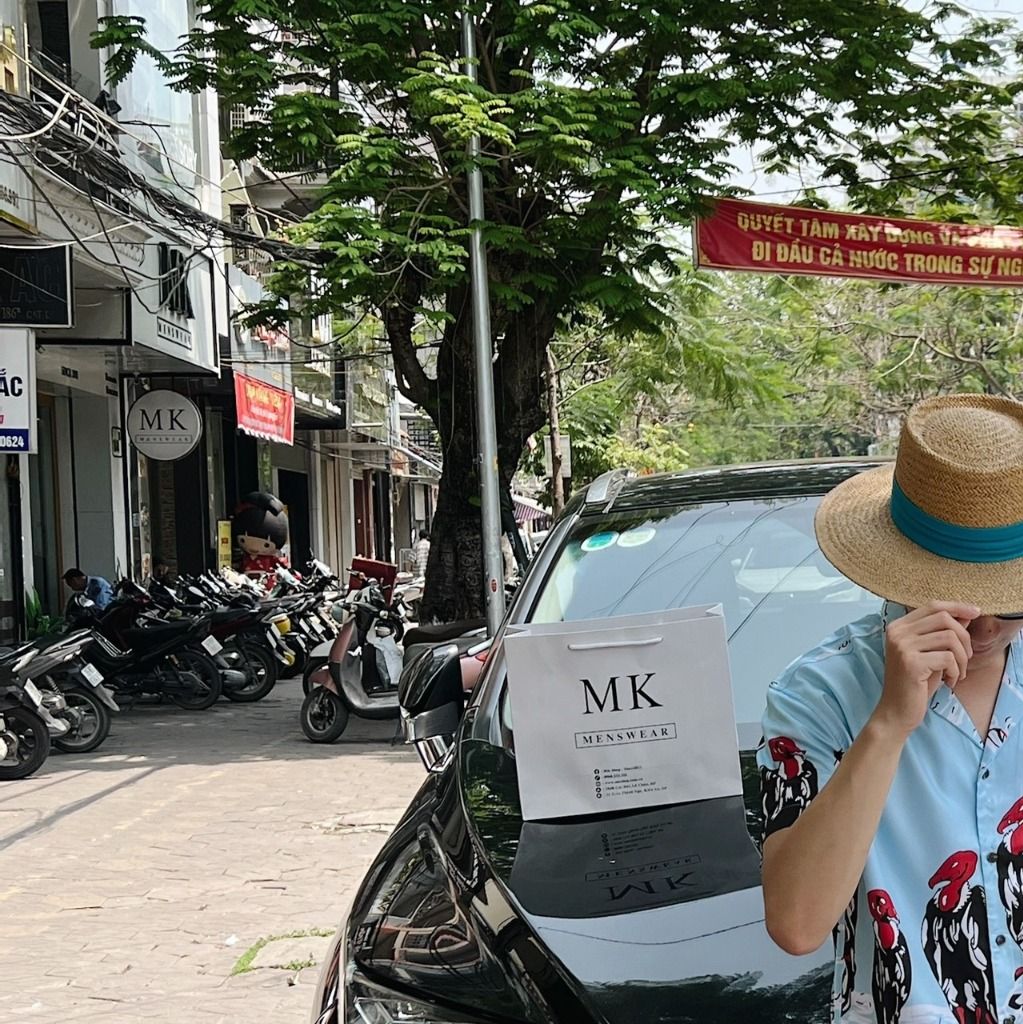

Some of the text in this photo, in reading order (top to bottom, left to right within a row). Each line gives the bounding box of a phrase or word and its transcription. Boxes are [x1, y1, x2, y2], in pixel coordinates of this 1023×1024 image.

[737, 209, 794, 235] QUYẾT
[800, 217, 839, 240] TÂM
[752, 239, 771, 262] ĐI
[776, 236, 814, 265] ĐẦU
[819, 243, 844, 267] CẢ
[849, 247, 899, 271] NƯỚC
[904, 252, 963, 275] TRONG
[968, 254, 994, 279] SỰ
[140, 408, 187, 431] MK
[579, 672, 664, 715] MK
[582, 727, 670, 745] MENSWEAR
